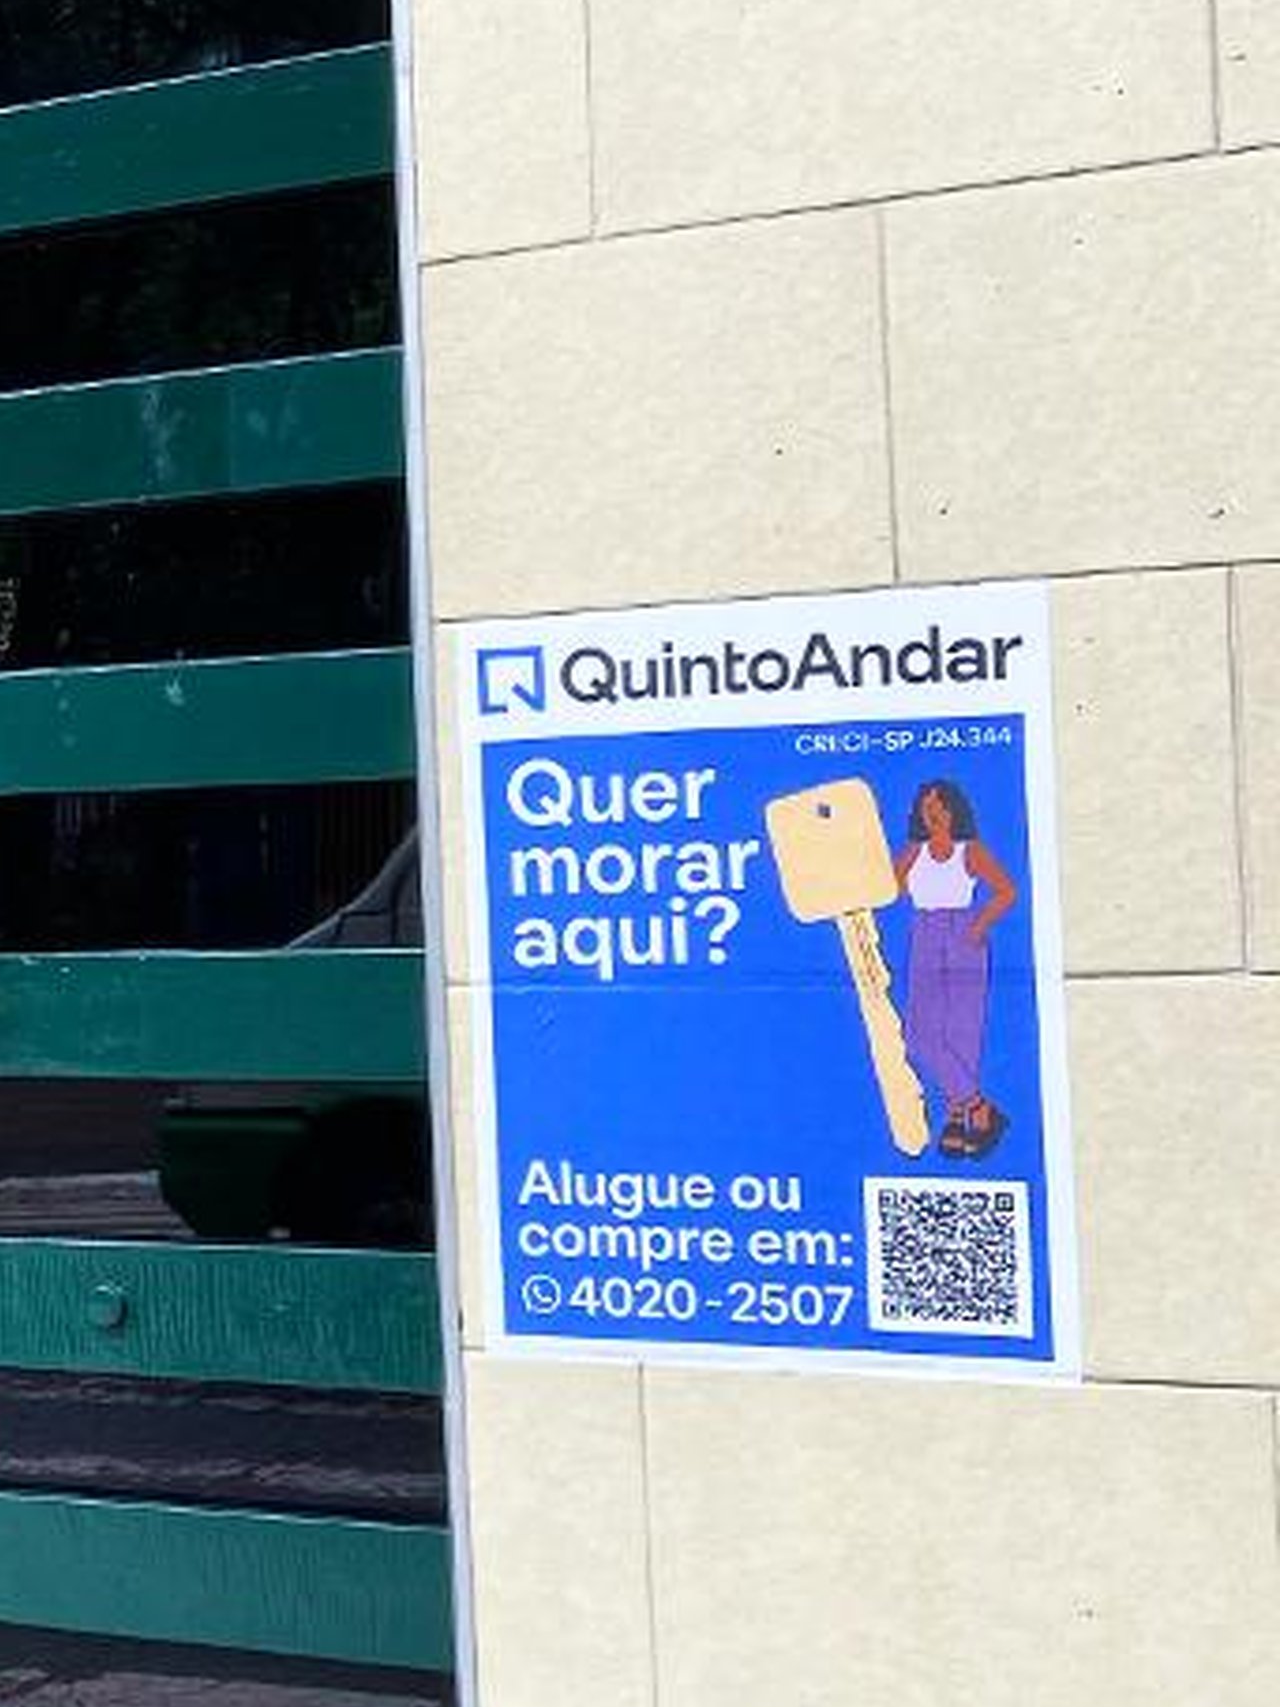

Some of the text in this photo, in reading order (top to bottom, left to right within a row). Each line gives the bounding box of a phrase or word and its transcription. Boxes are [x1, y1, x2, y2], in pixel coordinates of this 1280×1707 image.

[560, 626, 1023, 704] QuintoAndar
[507, 759, 717, 827] Quer
[510, 837, 761, 895] morar
[513, 897, 741, 981] aqui?
[517, 1161, 801, 1217] Alugue ou
[518, 1220, 854, 1269] compre em:
